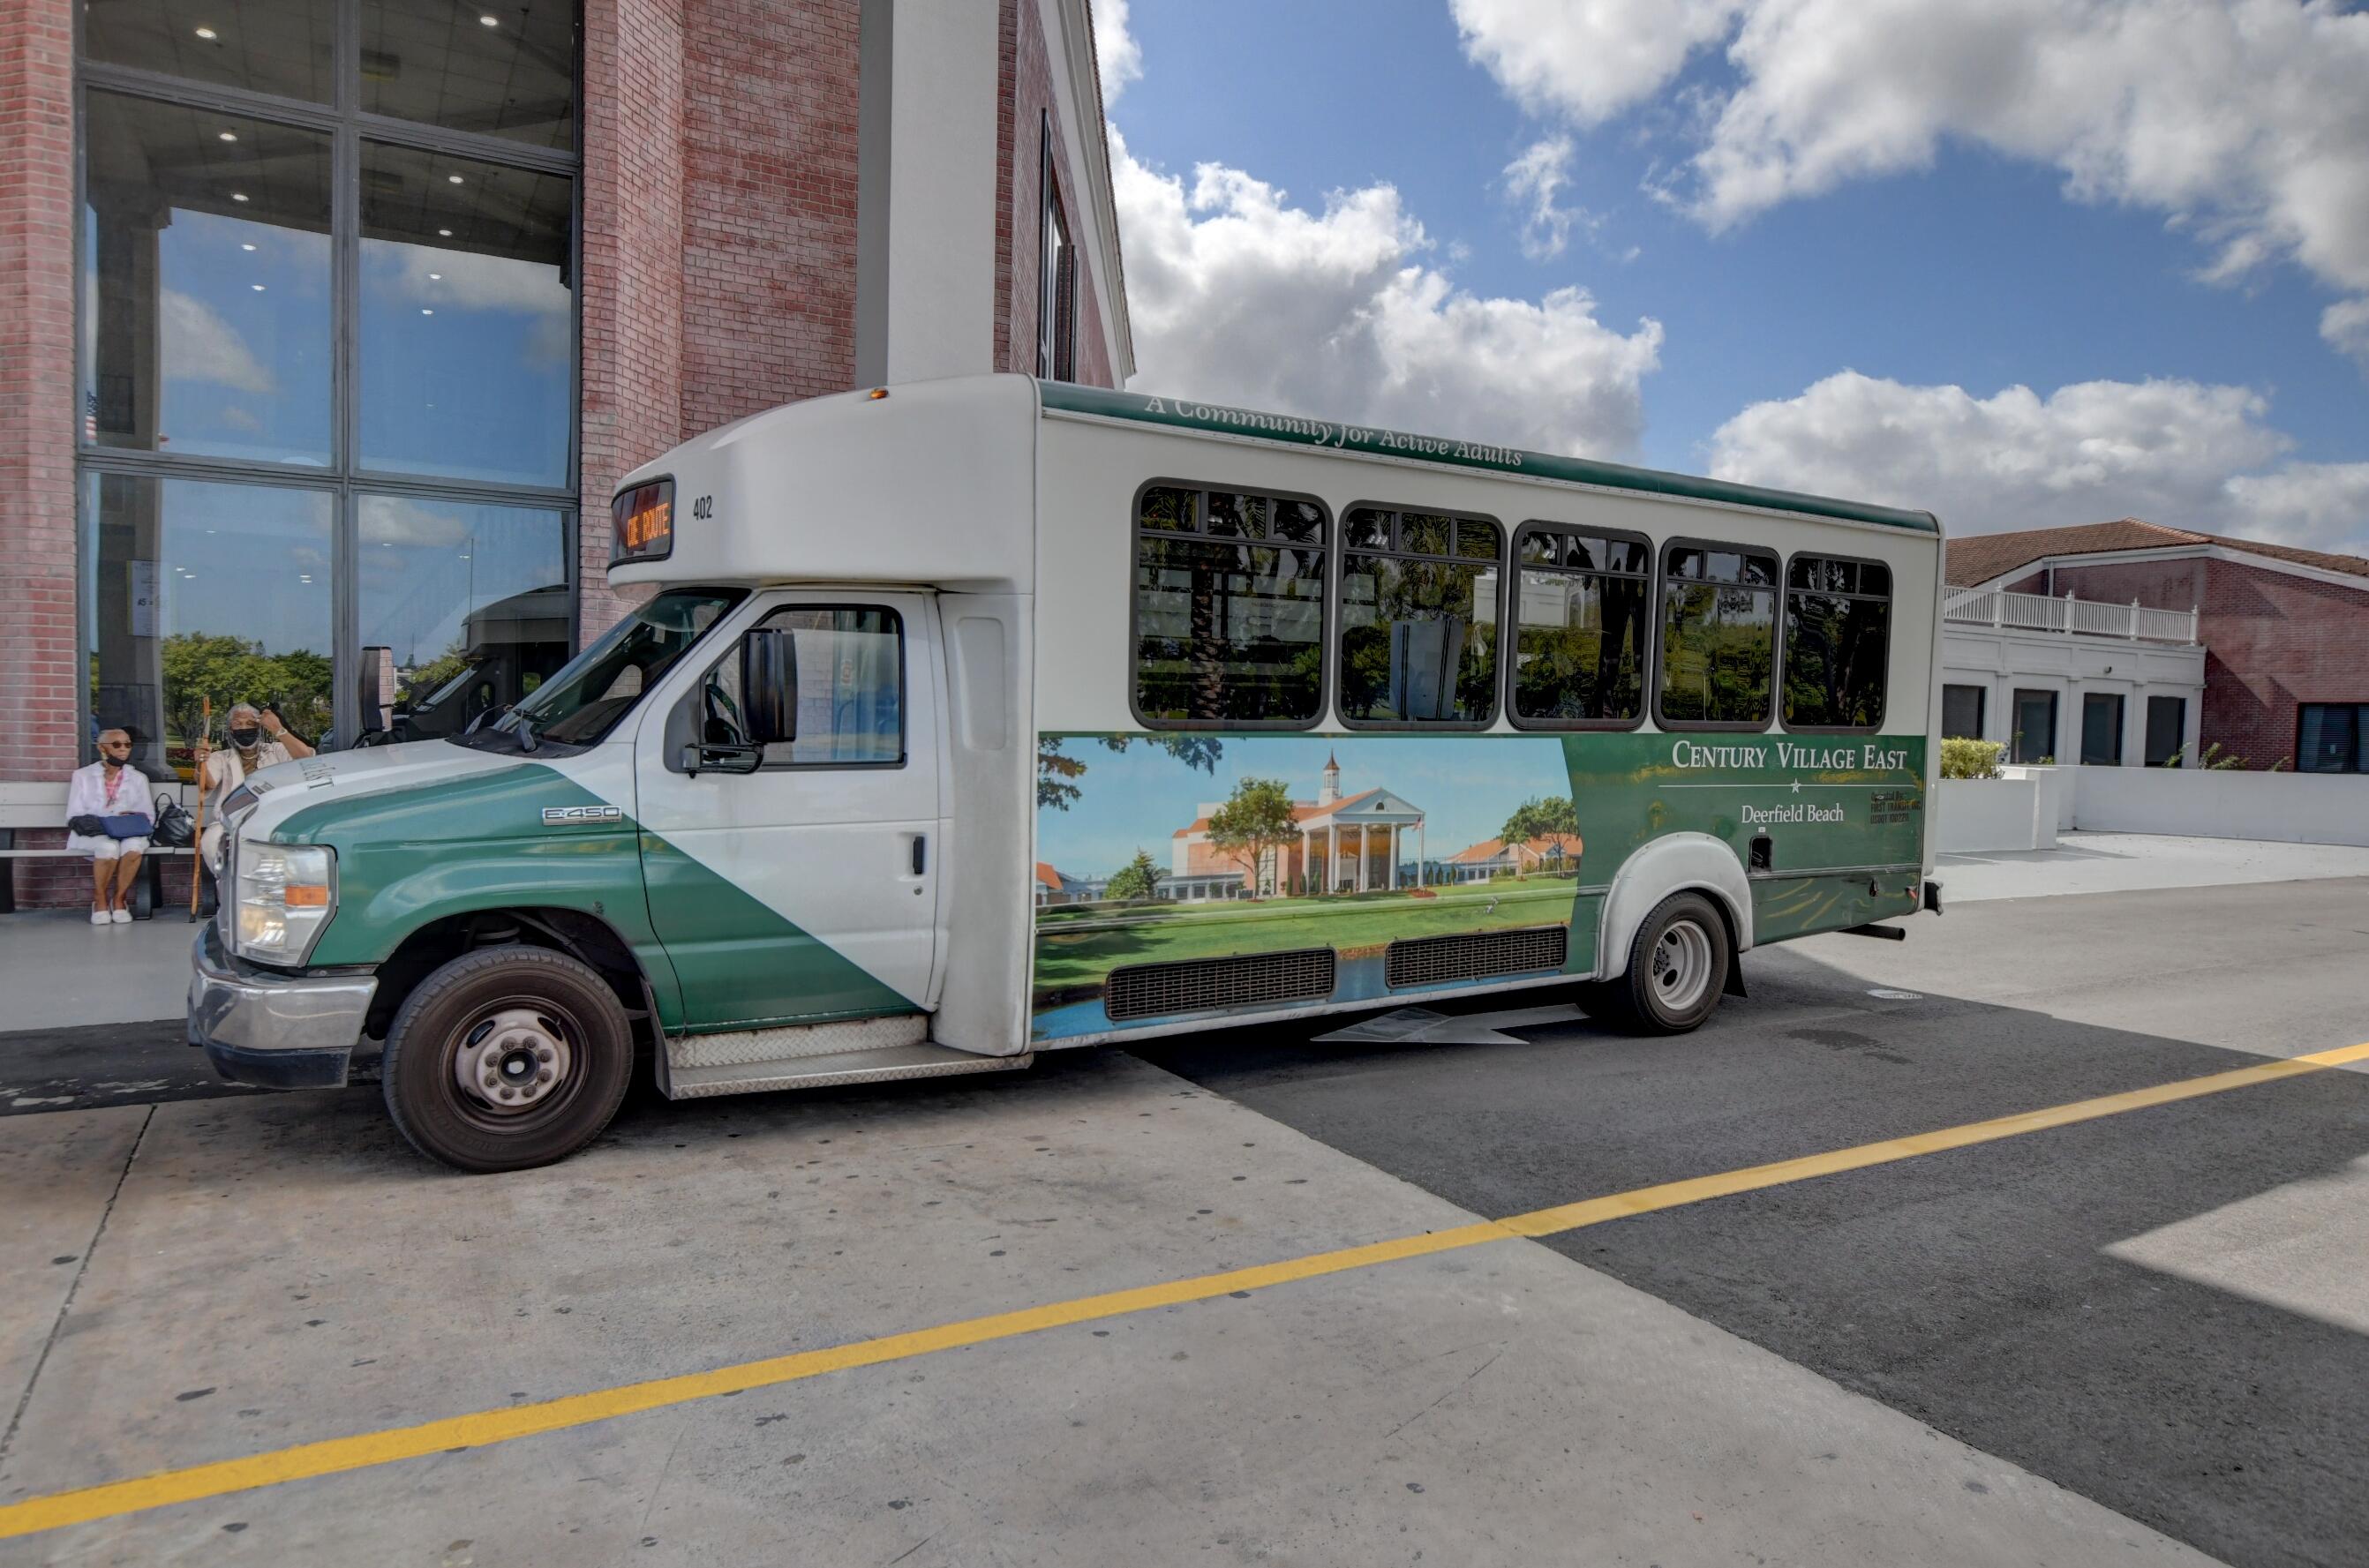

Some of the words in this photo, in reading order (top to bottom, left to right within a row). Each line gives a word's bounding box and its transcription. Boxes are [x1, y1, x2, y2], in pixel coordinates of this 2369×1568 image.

[1145, 396, 1166, 414] A
[1175, 401, 1333, 445] Community
[1335, 424, 1374, 448] for
[1379, 430, 1448, 455] Active
[1454, 440, 1523, 466] Adults
[694, 495, 712, 521] 402
[1672, 740, 1767, 769] CENTURY
[1776, 742, 1855, 769] VILLAGE
[1863, 745, 1907, 769] EAST
[1741, 804, 1804, 823] Deerfield
[1808, 803, 1844, 822] Beach
